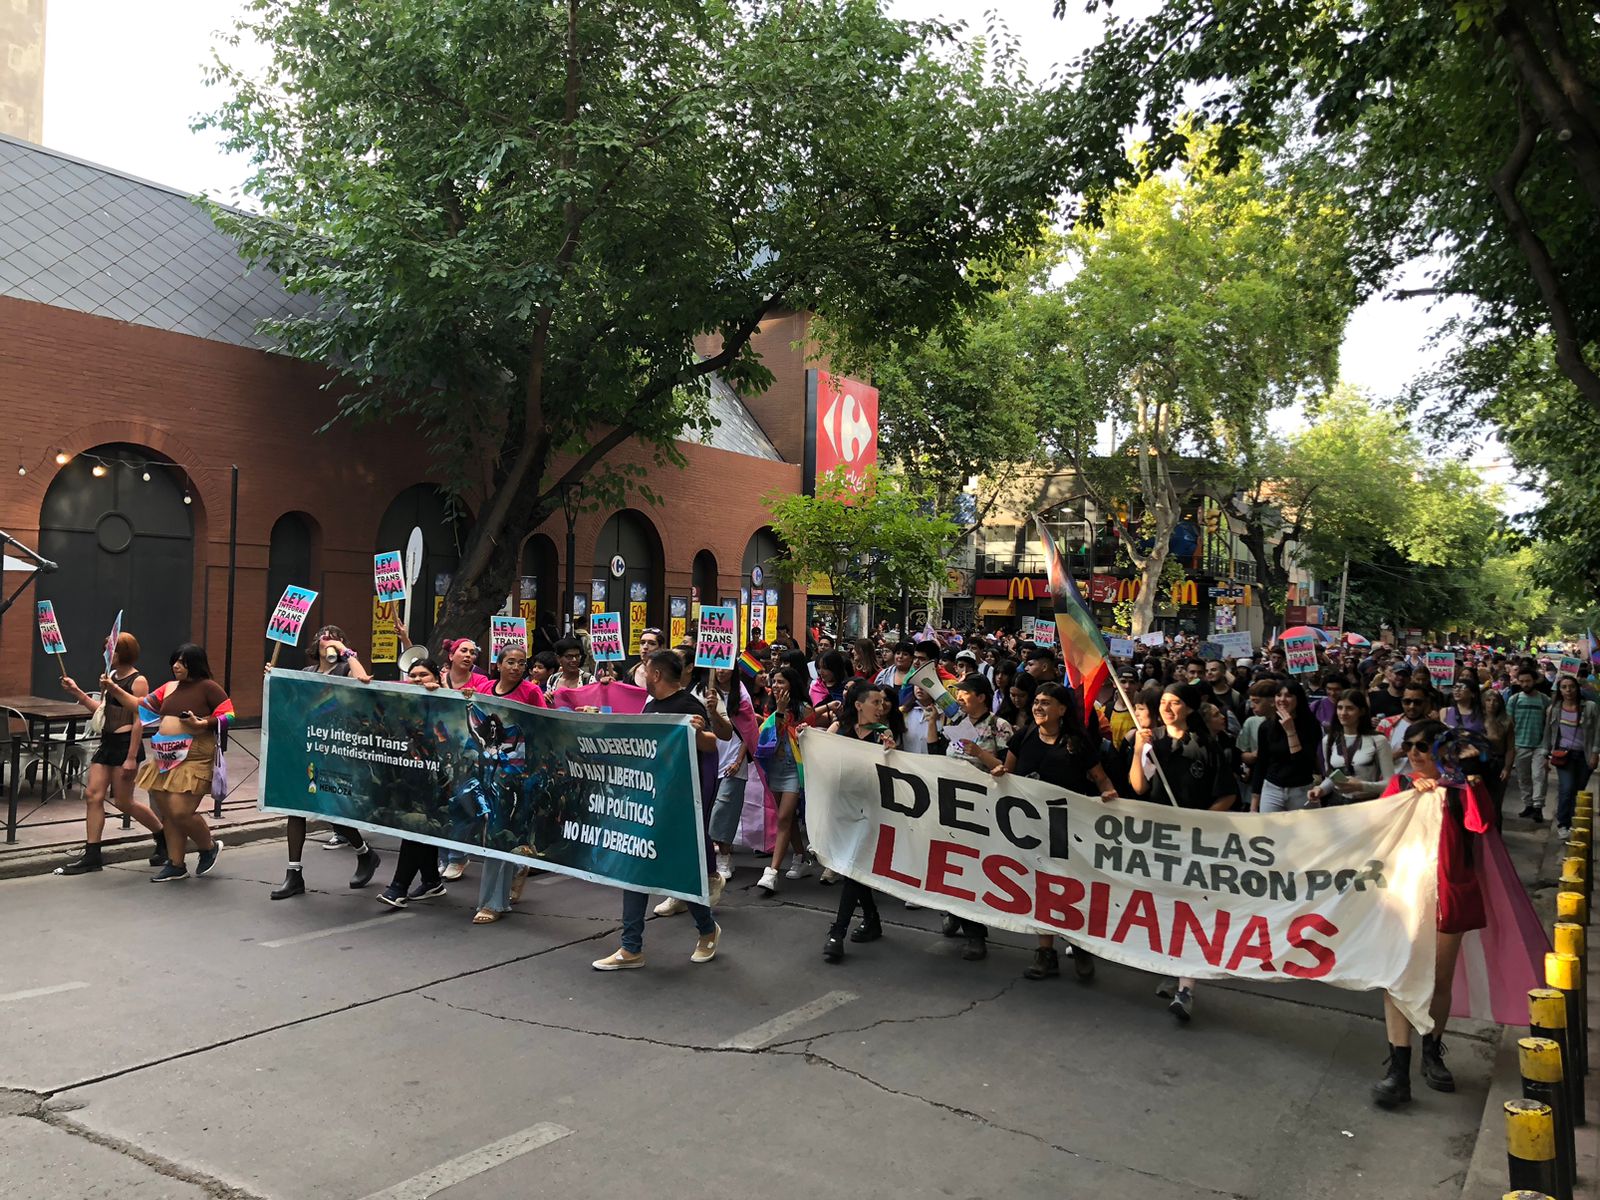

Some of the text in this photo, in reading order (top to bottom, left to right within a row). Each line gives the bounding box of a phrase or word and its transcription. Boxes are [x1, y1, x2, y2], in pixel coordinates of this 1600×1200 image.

[376, 557, 392, 570] LEY
[377, 573, 400, 583] TRANS
[378, 580, 402, 596] ¡YA!
[282, 590, 305, 605] LEY
[277, 608, 302, 622] TRANS
[279, 602, 306, 614] INTEGRAL
[592, 617, 611, 629] LEY
[701, 611, 725, 626] LEY
[270, 617, 298, 637] ¡YA!
[493, 621, 516, 632] LEY
[700, 626, 733, 634] INTEGRAL
[495, 638, 524, 646] TRANS
[701, 634, 732, 644] TRANS
[1287, 640, 1305, 649] LEY
[593, 642, 620, 655] ¡YA!
[699, 644, 731, 660] ¡YA!
[156, 740, 188, 751] INTEGRAL
[307, 725, 409, 752] ¡Ley Integral Trans
[577, 736, 658, 759] SIN DERECHOS
[306, 741, 441, 772] y Ley Antidiscriminatoria YA!
[568, 760, 656, 799] NO HAY LIBERTAD,
[320, 784, 352, 796] MENDOZA
[588, 793, 654, 827] SIN POLÍTICAS
[875, 763, 1069, 859] DECÍ
[563, 820, 657, 860] NO HAY DERECHOS
[1094, 814, 1275, 867] QUE LAS
[1094, 843, 1387, 901] MATARON POR
[872, 823, 1340, 979] LESBIANAS
